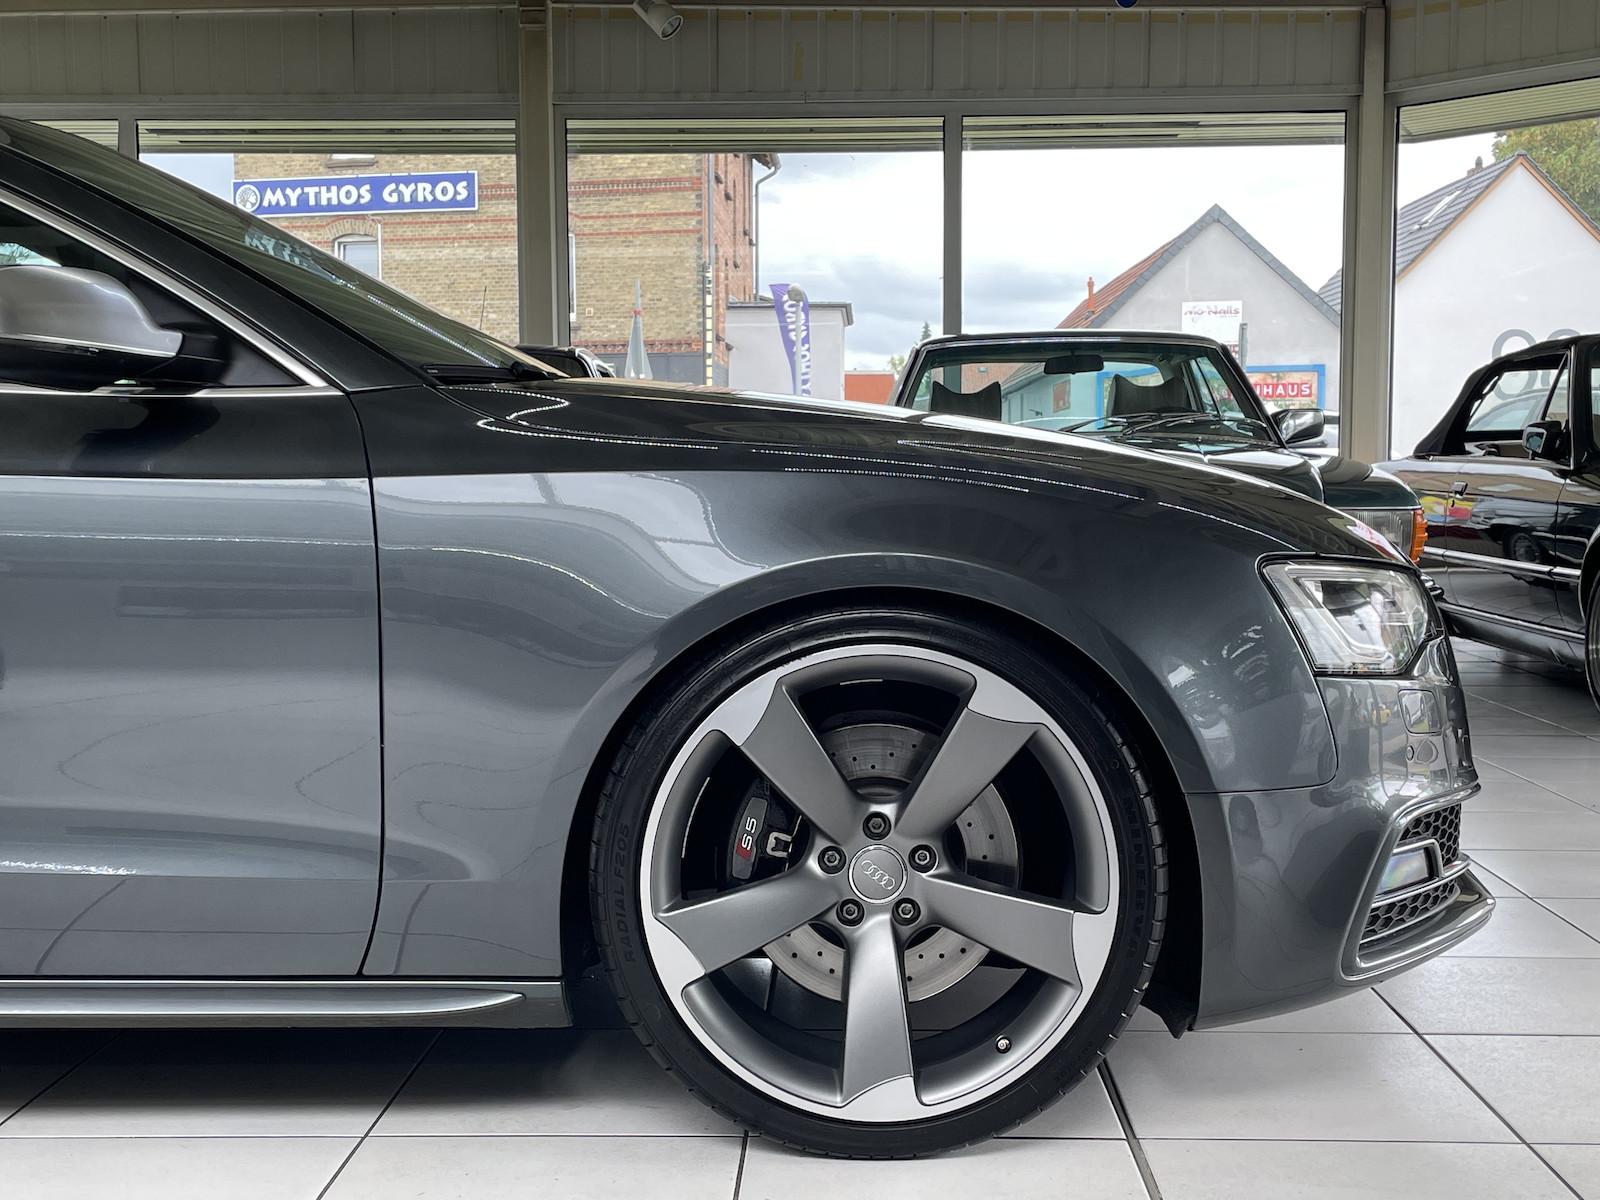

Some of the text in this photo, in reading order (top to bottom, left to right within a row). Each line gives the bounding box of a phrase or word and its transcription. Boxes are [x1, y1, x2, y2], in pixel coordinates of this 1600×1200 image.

[262, 181, 469, 208] MYTHOS GYROS
[1207, 305, 1240, 315] Nails
[741, 816, 757, 851] S5
[614, 822, 636, 962] RADIAL F205
